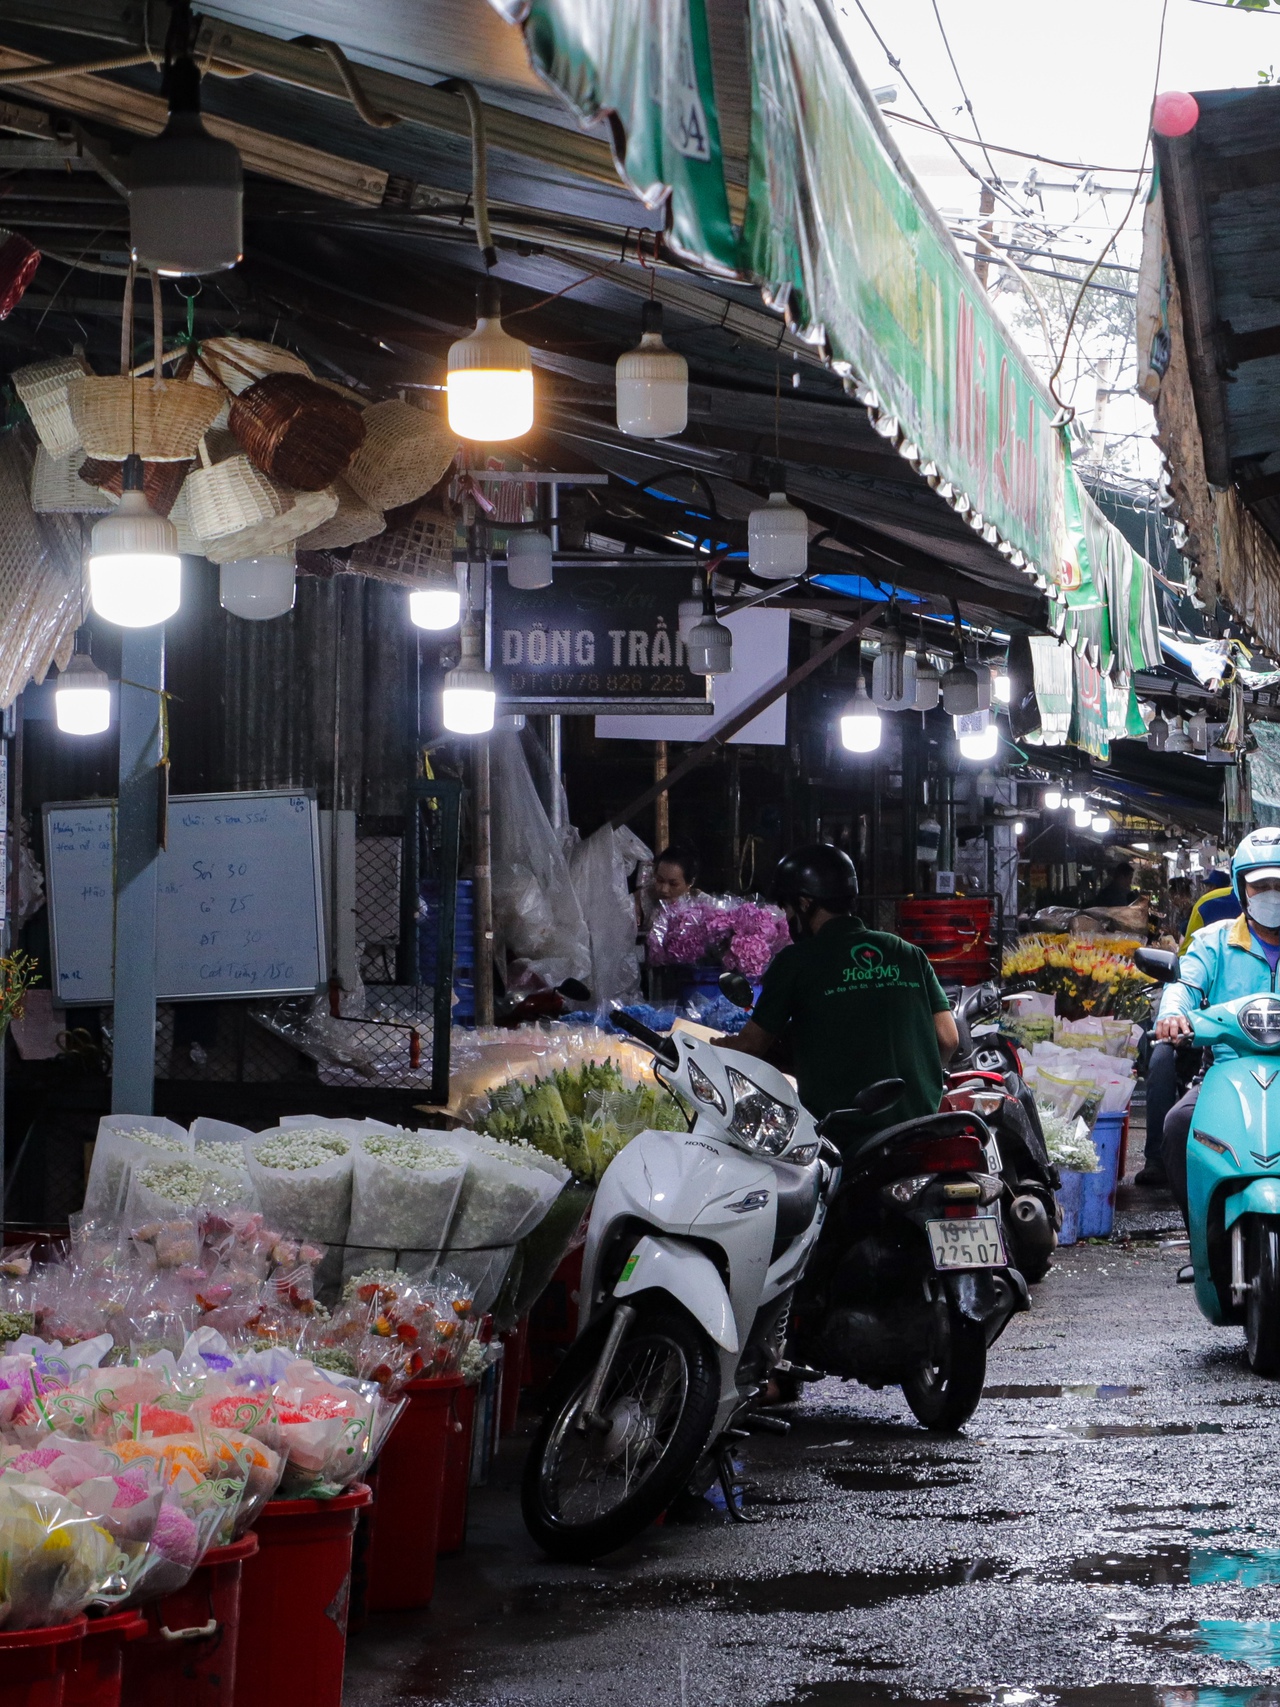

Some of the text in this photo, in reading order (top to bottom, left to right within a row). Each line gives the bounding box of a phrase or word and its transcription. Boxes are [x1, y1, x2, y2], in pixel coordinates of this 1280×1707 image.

[551, 673, 599, 691] 0778
[606, 673, 643, 691] 828
[650, 673, 686, 691] 225
[228, 863, 247, 878] 30
[230, 893, 254, 914] 25
[842, 963, 900, 982] Hoa Mỹ
[684, 1140, 720, 1156] HONDA
